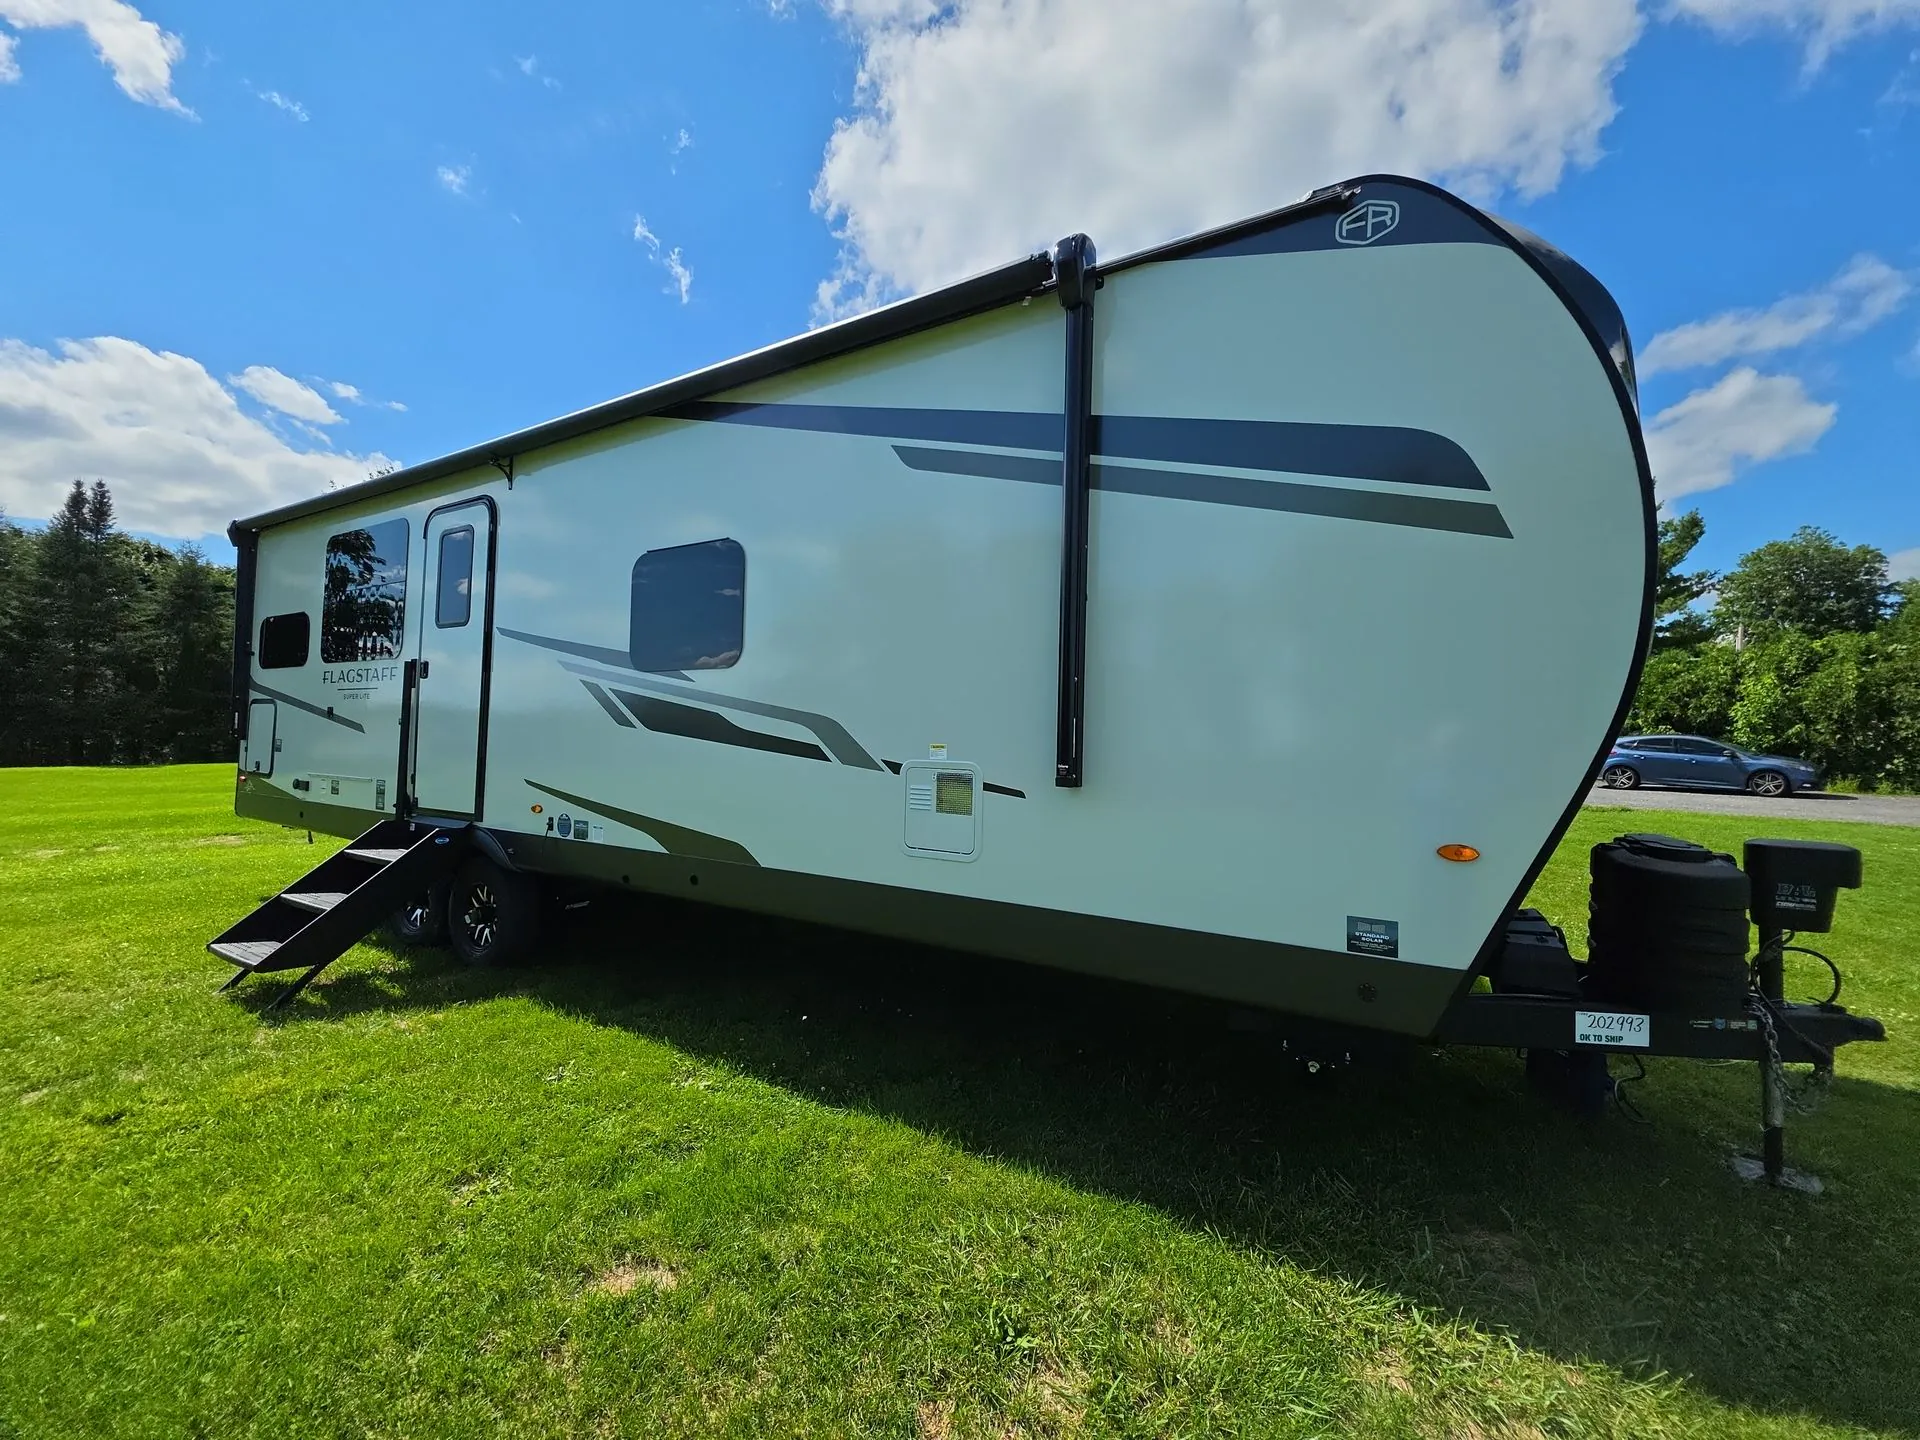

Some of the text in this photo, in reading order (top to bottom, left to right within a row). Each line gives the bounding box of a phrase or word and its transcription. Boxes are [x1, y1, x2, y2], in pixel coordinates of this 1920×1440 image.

[1342, 206, 1392, 238] FR
[322, 667, 398, 684] FLAGSTAFF
[1355, 931, 1389, 940] STANDARD
[1588, 1014, 1644, 1032] 202993
[1605, 1035, 1624, 1043] SHIP
